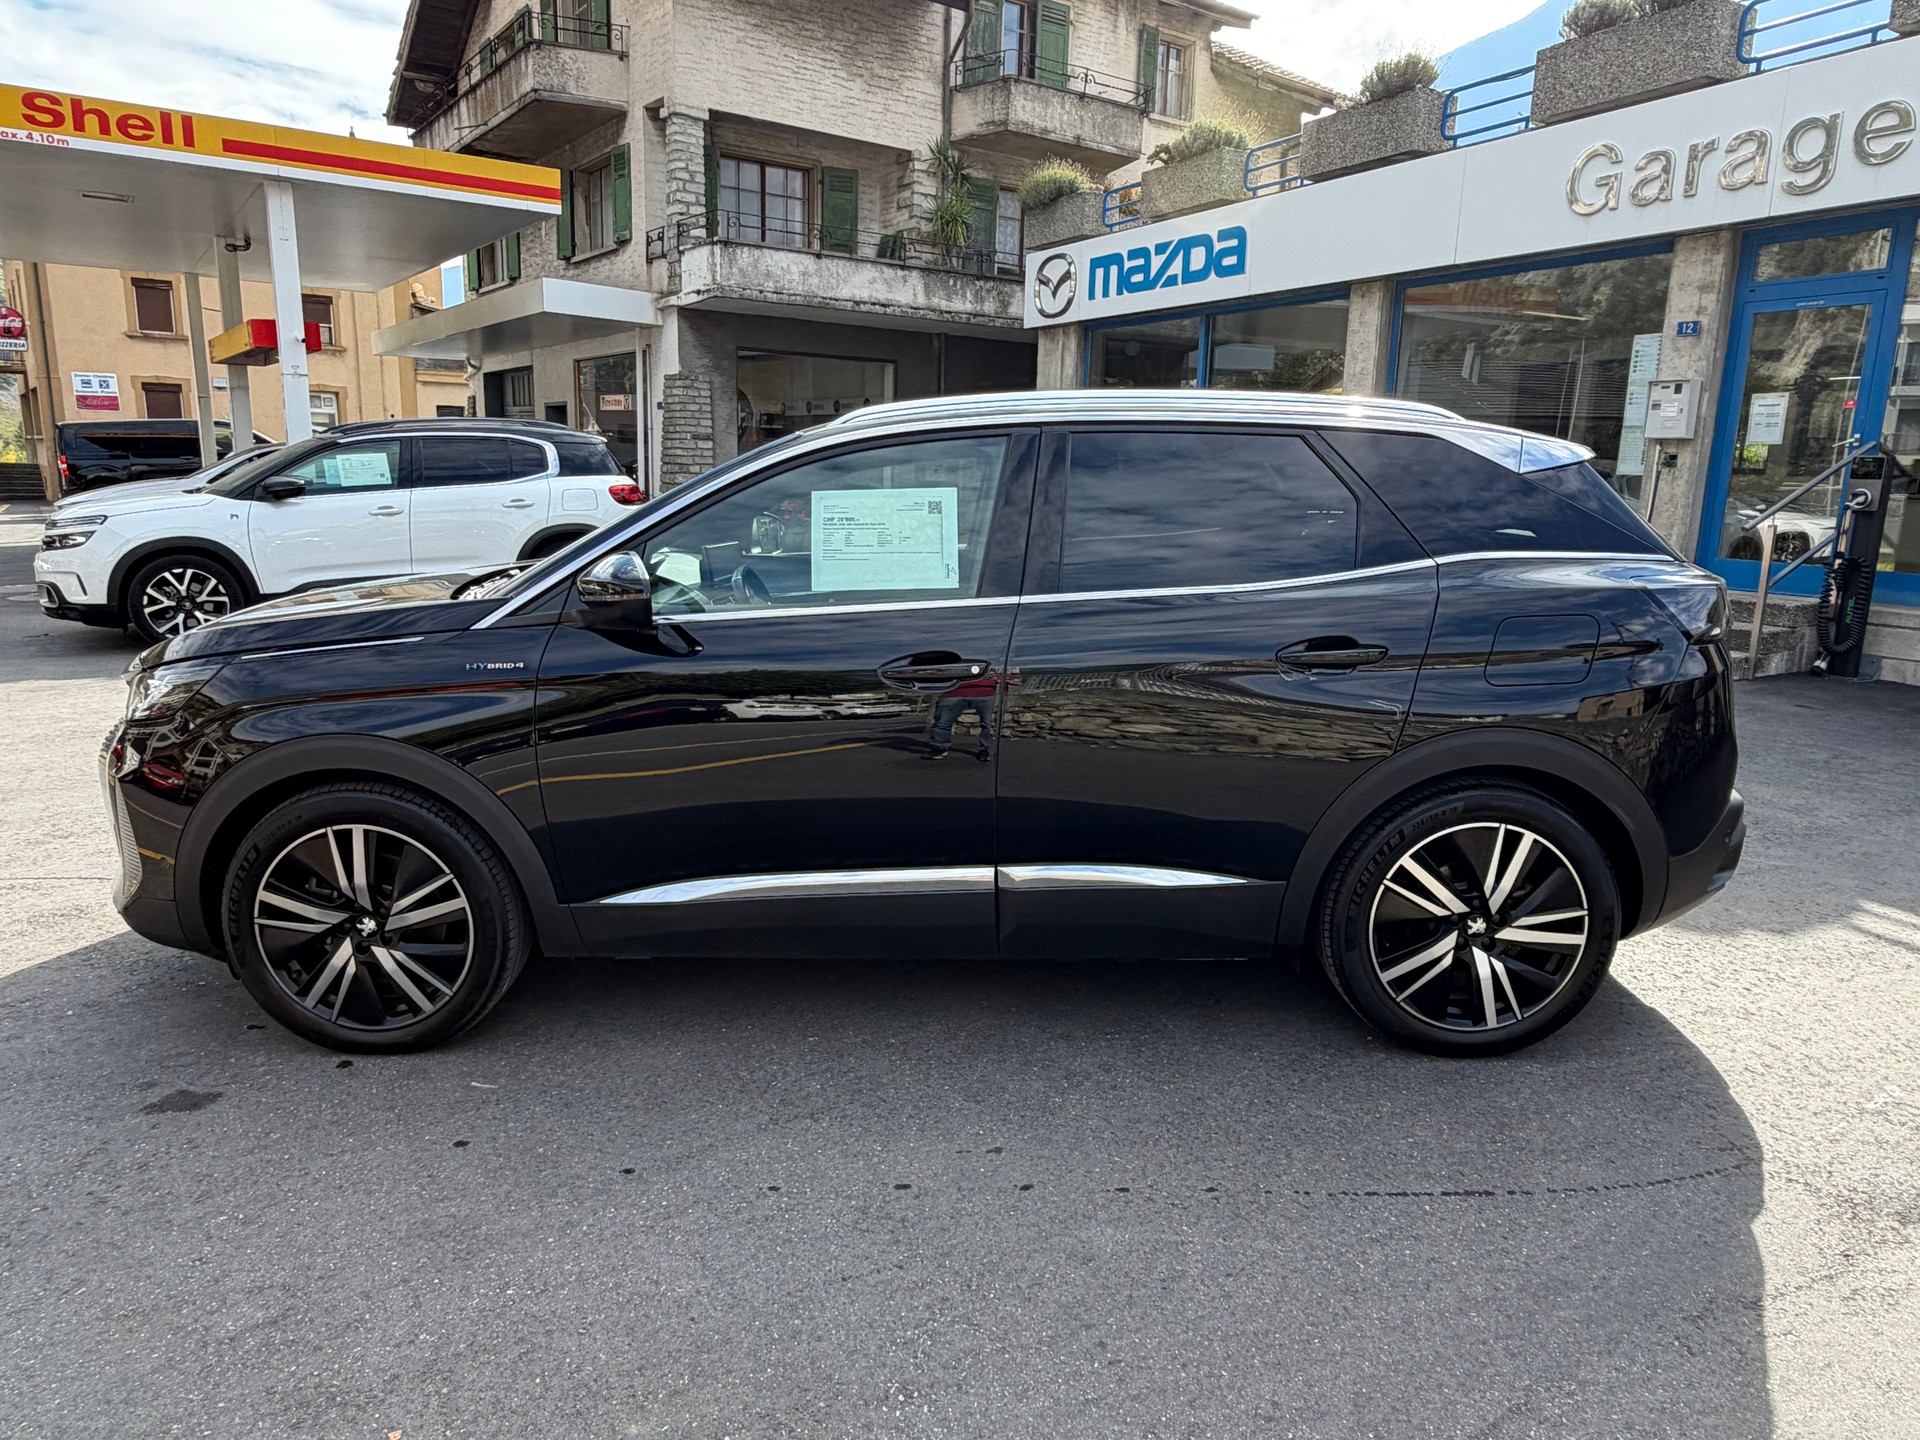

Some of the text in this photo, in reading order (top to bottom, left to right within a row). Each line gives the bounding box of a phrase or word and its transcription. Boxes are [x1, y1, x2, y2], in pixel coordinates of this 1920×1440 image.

[0, 130, 70, 147] ax. 4.10m
[21, 91, 196, 148] Shell
[1566, 99, 1917, 216] Garage
[1088, 225, 1247, 301] mazda
[0, 341, 26, 349] IZZERIA
[1682, 322, 1694, 334] 12
[465, 662, 524, 670] HYBRID4
[229, 847, 259, 937] MICHELIN
[1348, 833, 1403, 918] MICHELIN
